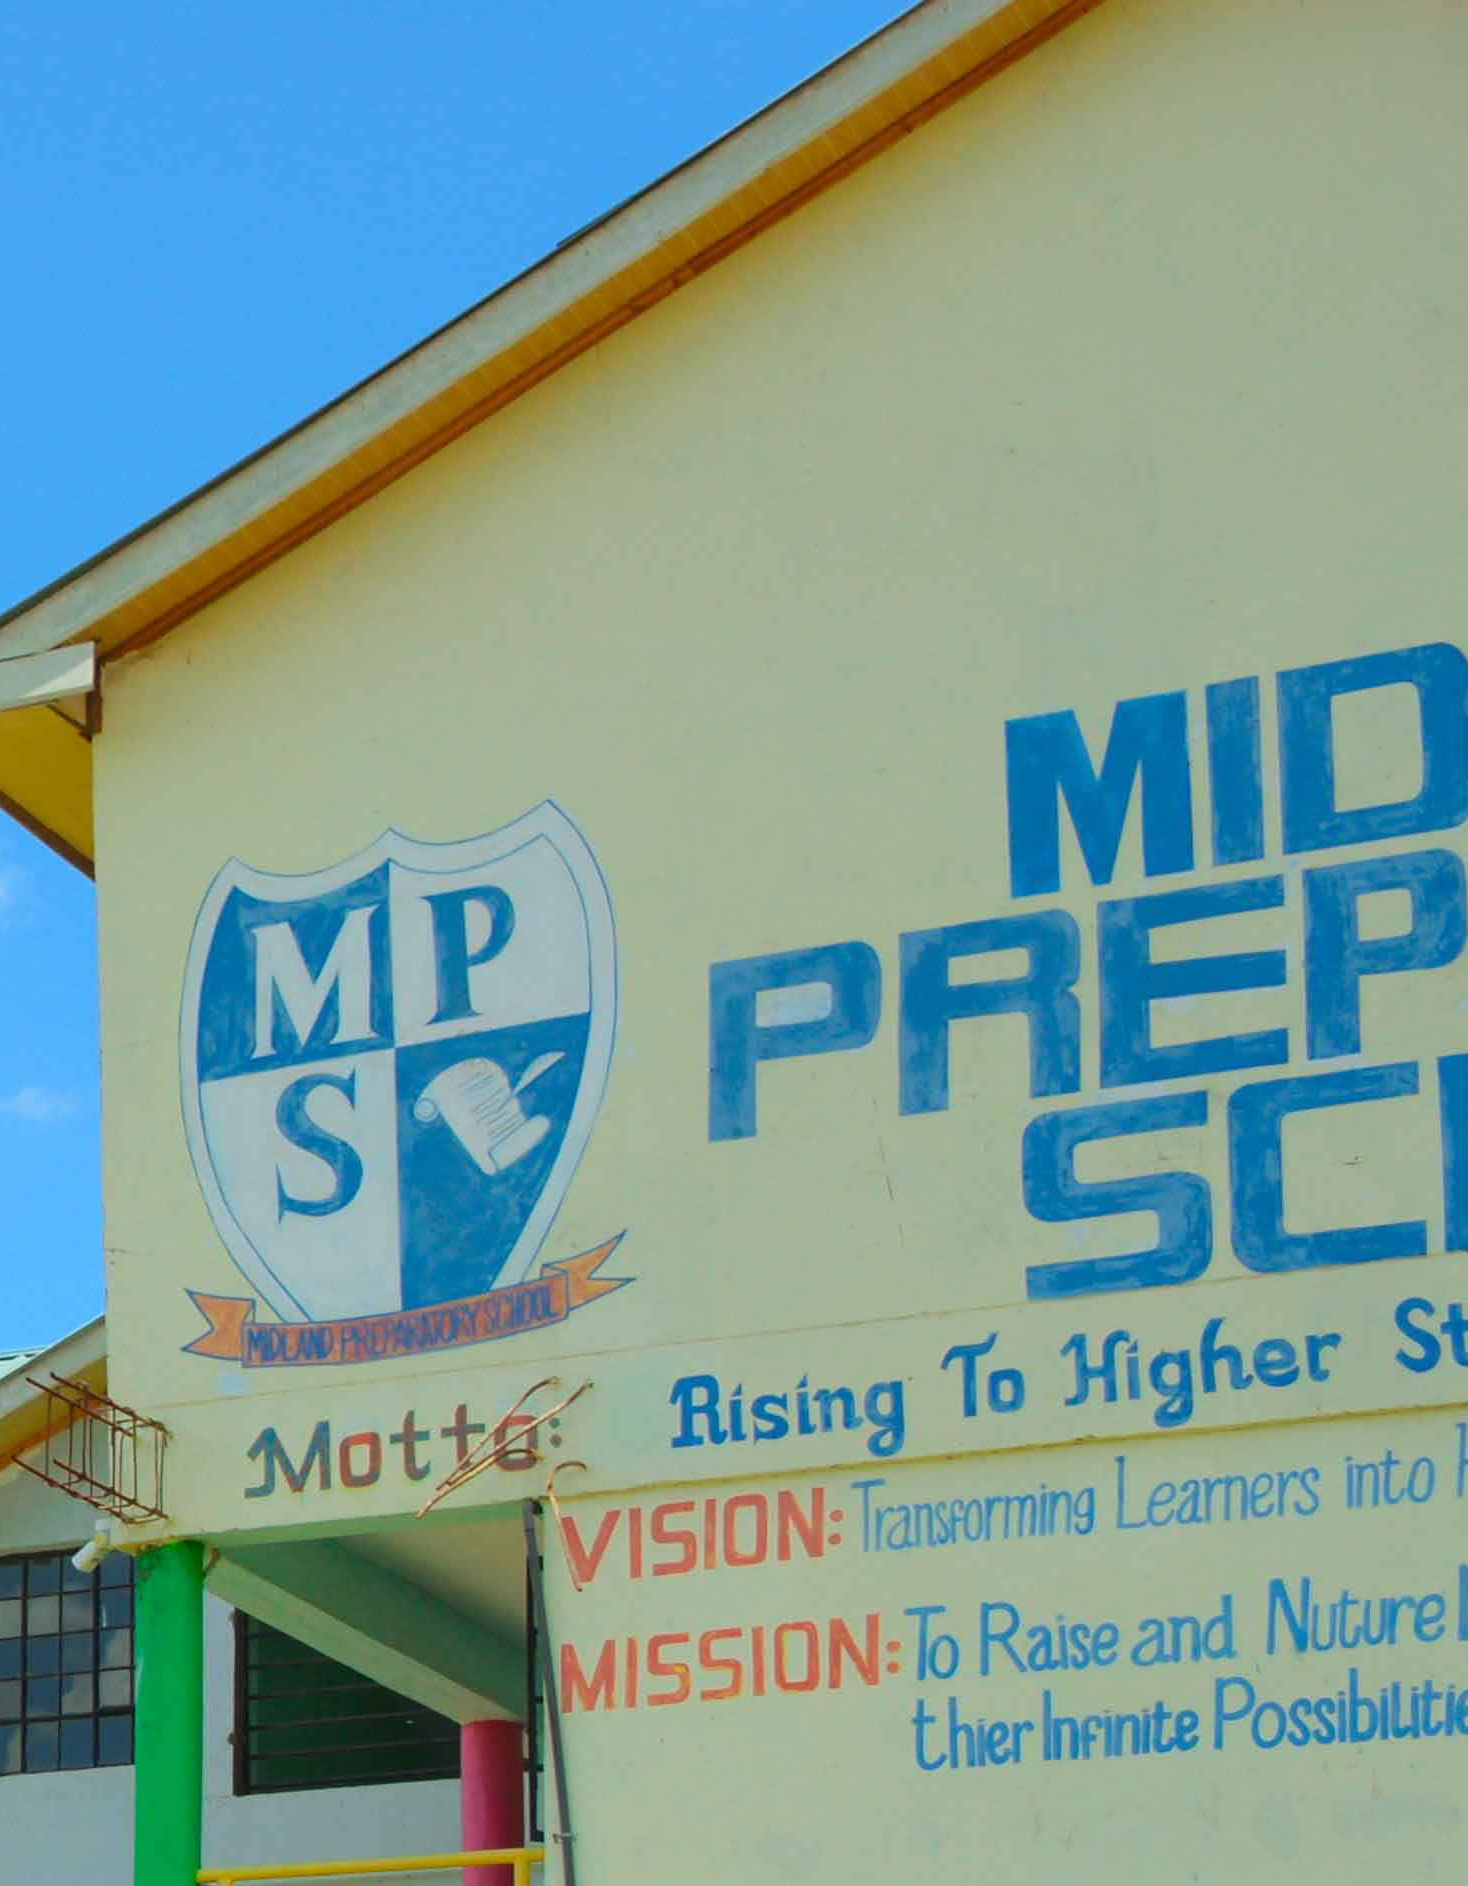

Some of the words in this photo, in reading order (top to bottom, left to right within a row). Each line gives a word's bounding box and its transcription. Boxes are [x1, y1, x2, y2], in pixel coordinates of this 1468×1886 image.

[1005, 642, 1468, 898] MID
[251, 904, 383, 1057] M
[424, 884, 516, 1018] P
[708, 848, 1468, 1142] PREP
[276, 1067, 365, 1221] S
[1021, 1052, 1468, 1299] SC
[246, 1326, 334, 1361] MIDLAND
[341, 1301, 478, 1357] PREPARATORY
[483, 1285, 555, 1329] SCHOOL
[668, 1374, 905, 1457] Rising
[940, 1331, 1026, 1418] To
[1061, 1317, 1341, 1427] Higher
[561, 1487, 845, 1584] VISION:
[850, 1478, 1096, 1552] Transforming
[1115, 1455, 1321, 1529] Learners
[1345, 1450, 1435, 1509] into
[560, 1613, 901, 1714] MISSION:
[903, 1605, 960, 1681] To
[980, 1602, 1121, 1676] Raise
[1130, 1594, 1237, 1665] and
[1266, 1576, 1446, 1656] Nuture
[910, 1697, 1035, 1771] thier
[1042, 1690, 1200, 1761] Infinite
